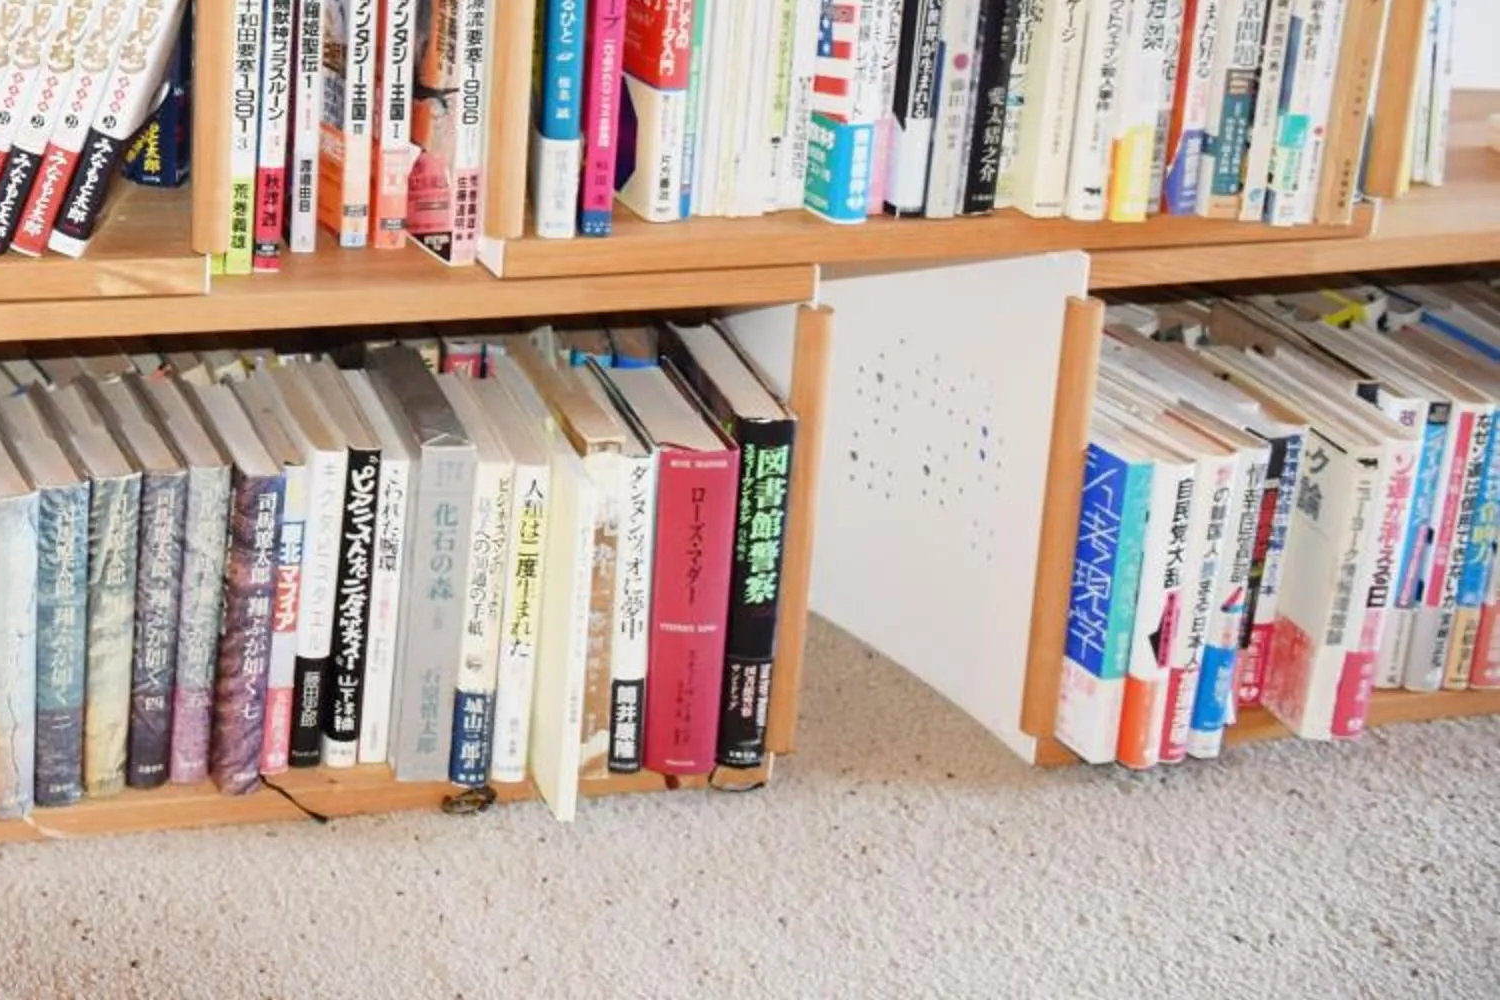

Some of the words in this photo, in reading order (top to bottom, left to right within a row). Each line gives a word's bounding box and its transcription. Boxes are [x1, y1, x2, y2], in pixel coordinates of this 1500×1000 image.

[23, 150, 69, 236] みなもと太郎
[67, 138, 113, 226] みなもと太郎
[429, 504, 458, 601] 化石の森
[685, 486, 708, 606] ローズ・マダー
[744, 445, 789, 605] 図書館警察
